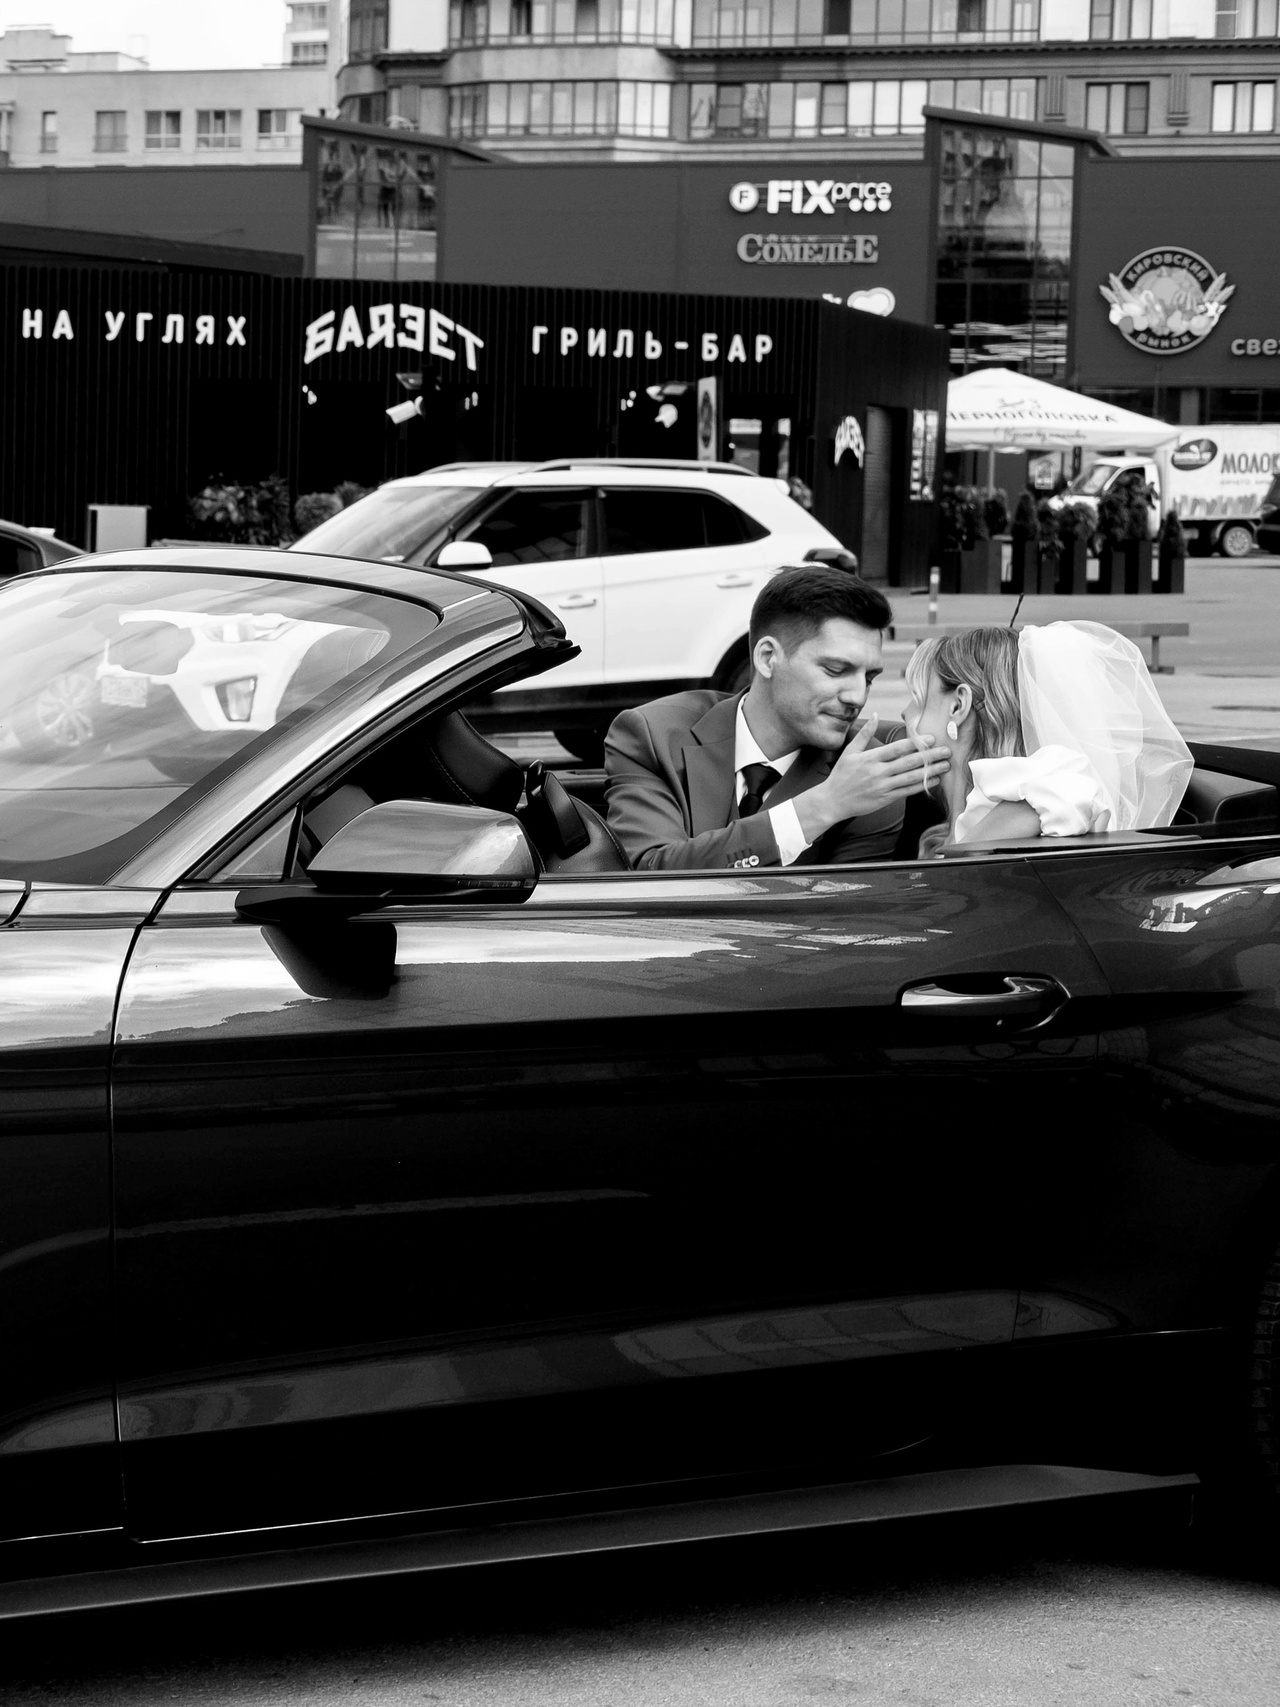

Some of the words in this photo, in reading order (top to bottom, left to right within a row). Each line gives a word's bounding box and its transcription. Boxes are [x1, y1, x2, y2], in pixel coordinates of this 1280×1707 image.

[831, 181, 893, 205] price
[1126, 253, 1209, 283] КИРОВСКИЙ
[23, 308, 74, 341] НА
[105, 311, 247, 347] УГЛЯХ
[532, 325, 773, 363] ГРИЛЬ-БАР
[1231, 338, 1280, 355] све
